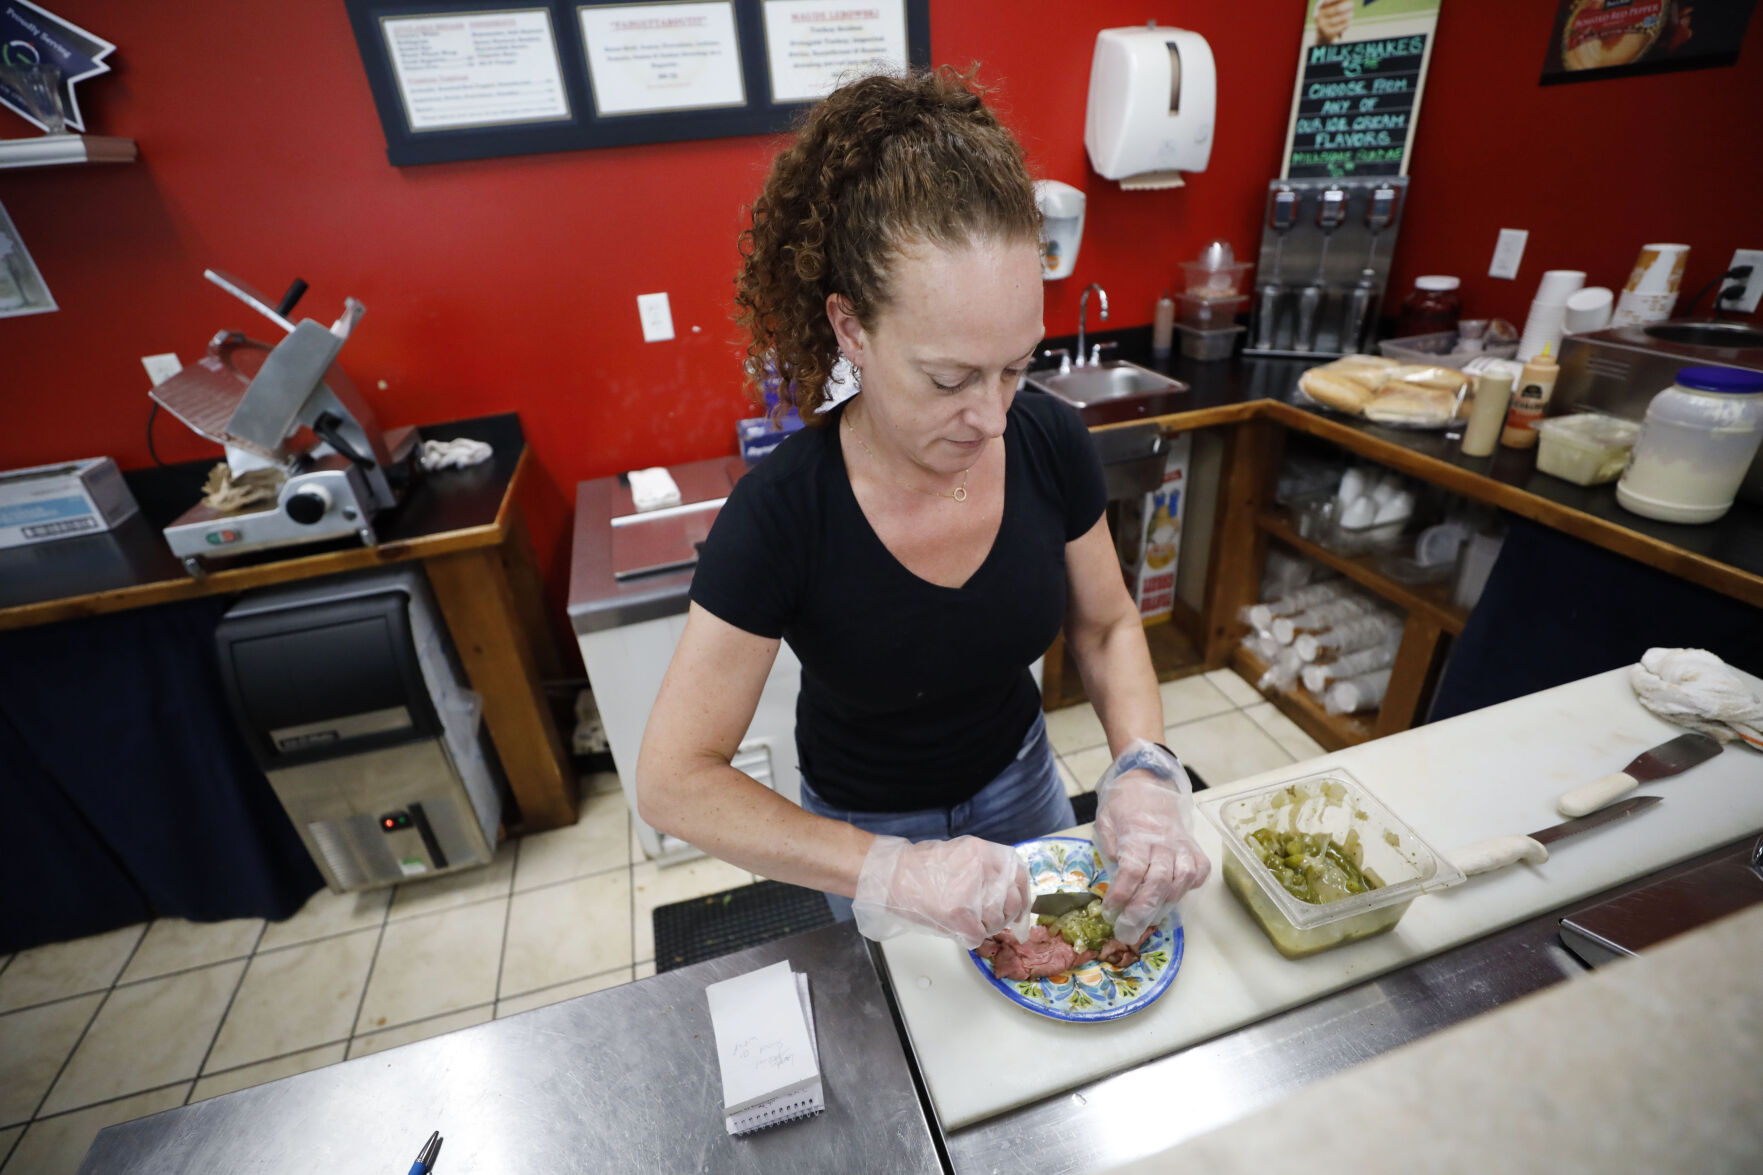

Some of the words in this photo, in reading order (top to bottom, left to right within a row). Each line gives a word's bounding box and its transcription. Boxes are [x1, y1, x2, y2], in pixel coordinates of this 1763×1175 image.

[6, 7, 41, 36] Proudly
[1611, 10, 1628, 20] RED
[1629, 4, 1659, 16] PEPPER
[1311, 36, 1423, 64] MILKSHAKES
[1308, 80, 1367, 99] CHOOSE
[1372, 78, 1408, 94] FROM
[1321, 100, 1351, 116] ANY
[1359, 97, 1379, 113] OF
[1296, 118, 1323, 134] OUR
[1325, 117, 1349, 132] ICE
[1352, 114, 1405, 130] CREAM
[1314, 130, 1391, 149] FLAVORS
